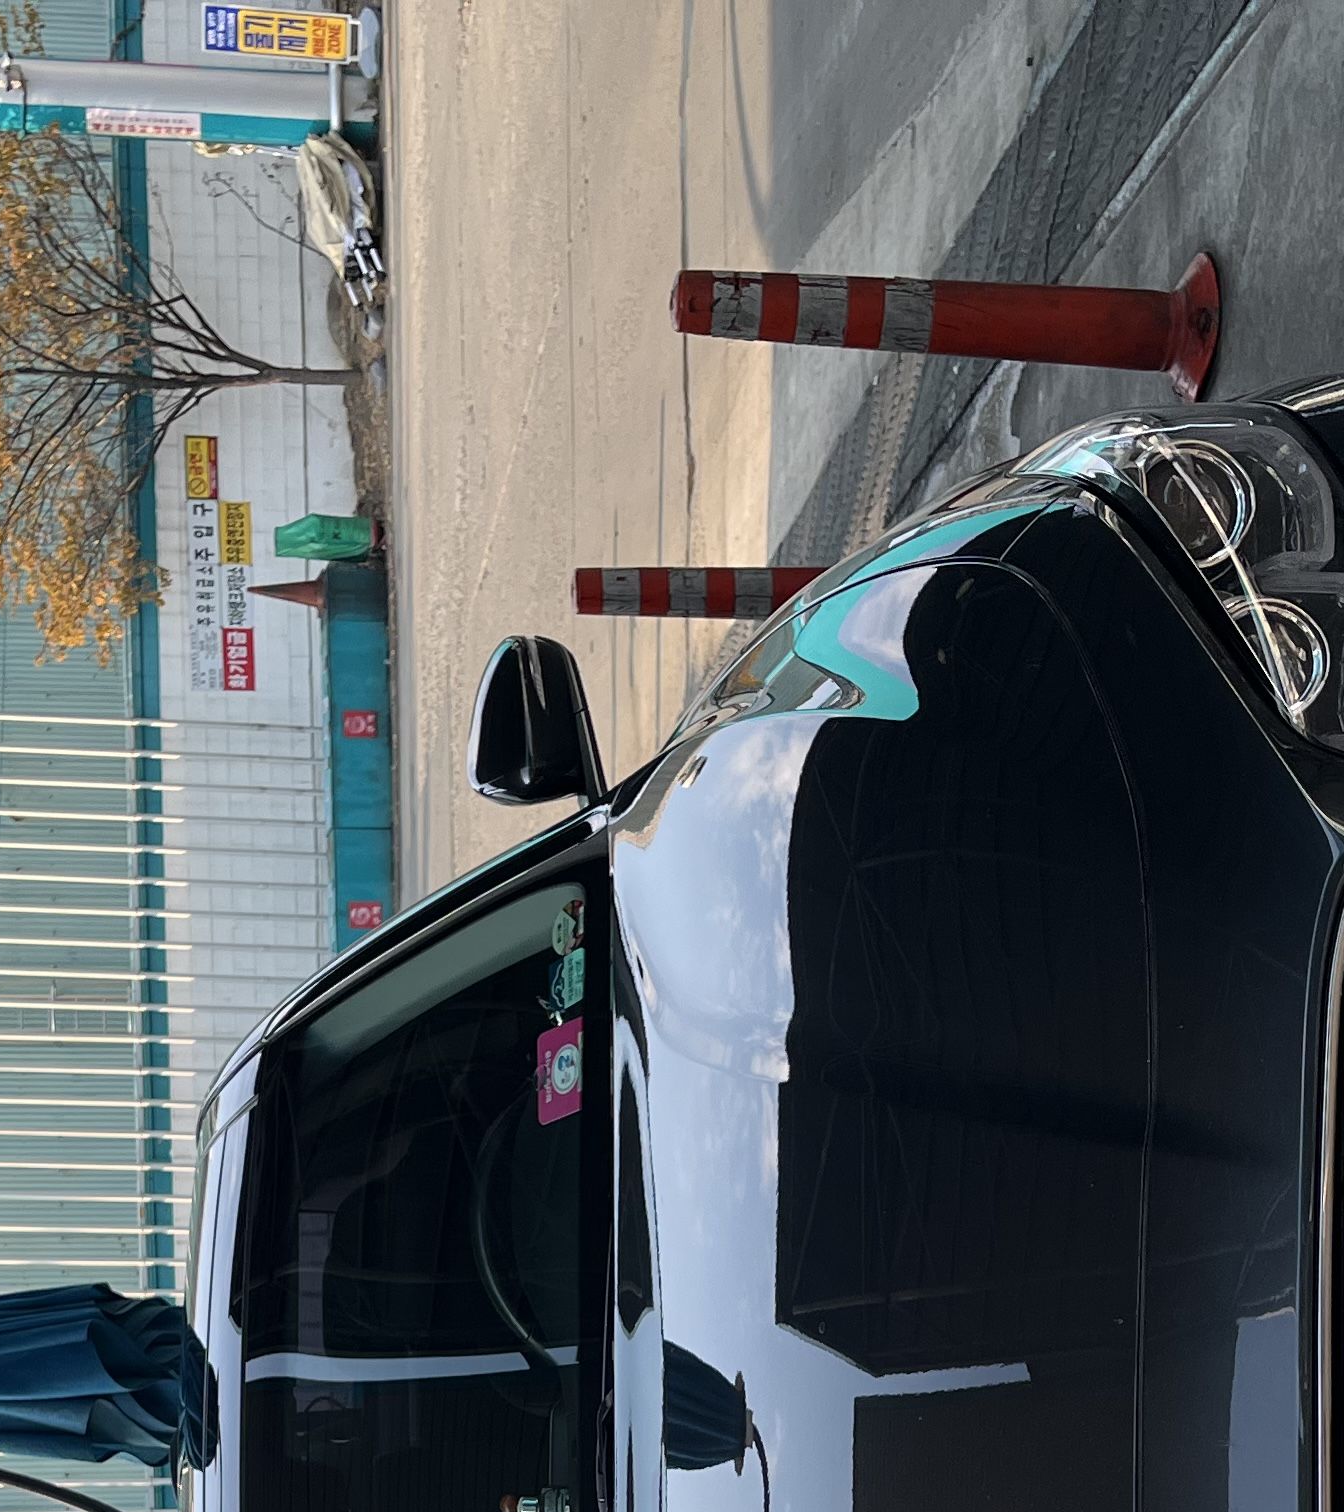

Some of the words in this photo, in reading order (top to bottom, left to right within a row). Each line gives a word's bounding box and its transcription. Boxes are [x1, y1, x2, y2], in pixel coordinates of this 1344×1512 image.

[277, 18, 308, 53] 제거
[328, 23, 342, 54] ZONE
[193, 504, 214, 561] 주입구
